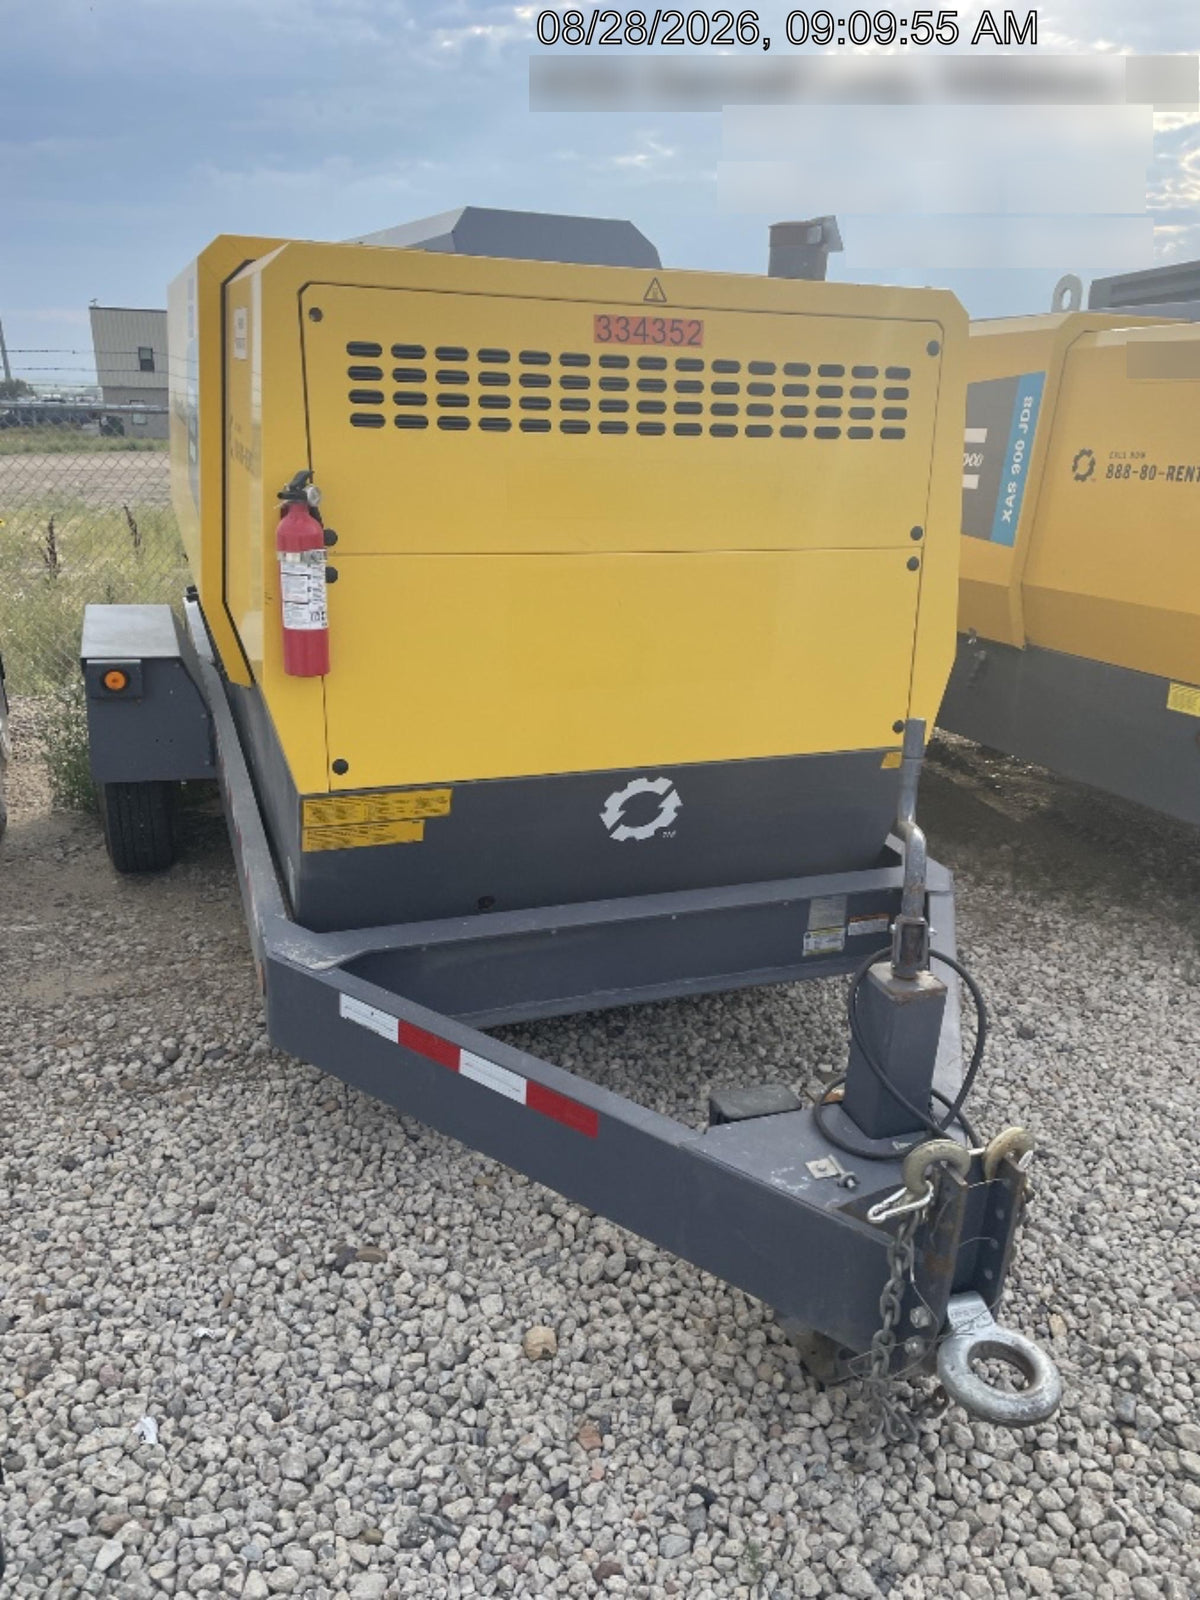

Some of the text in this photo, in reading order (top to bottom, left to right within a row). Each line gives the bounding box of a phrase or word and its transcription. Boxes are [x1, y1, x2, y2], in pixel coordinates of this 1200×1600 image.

[597, 315, 703, 346] 334352
[1001, 481, 1018, 523] XAS
[1011, 439, 1025, 475] 900
